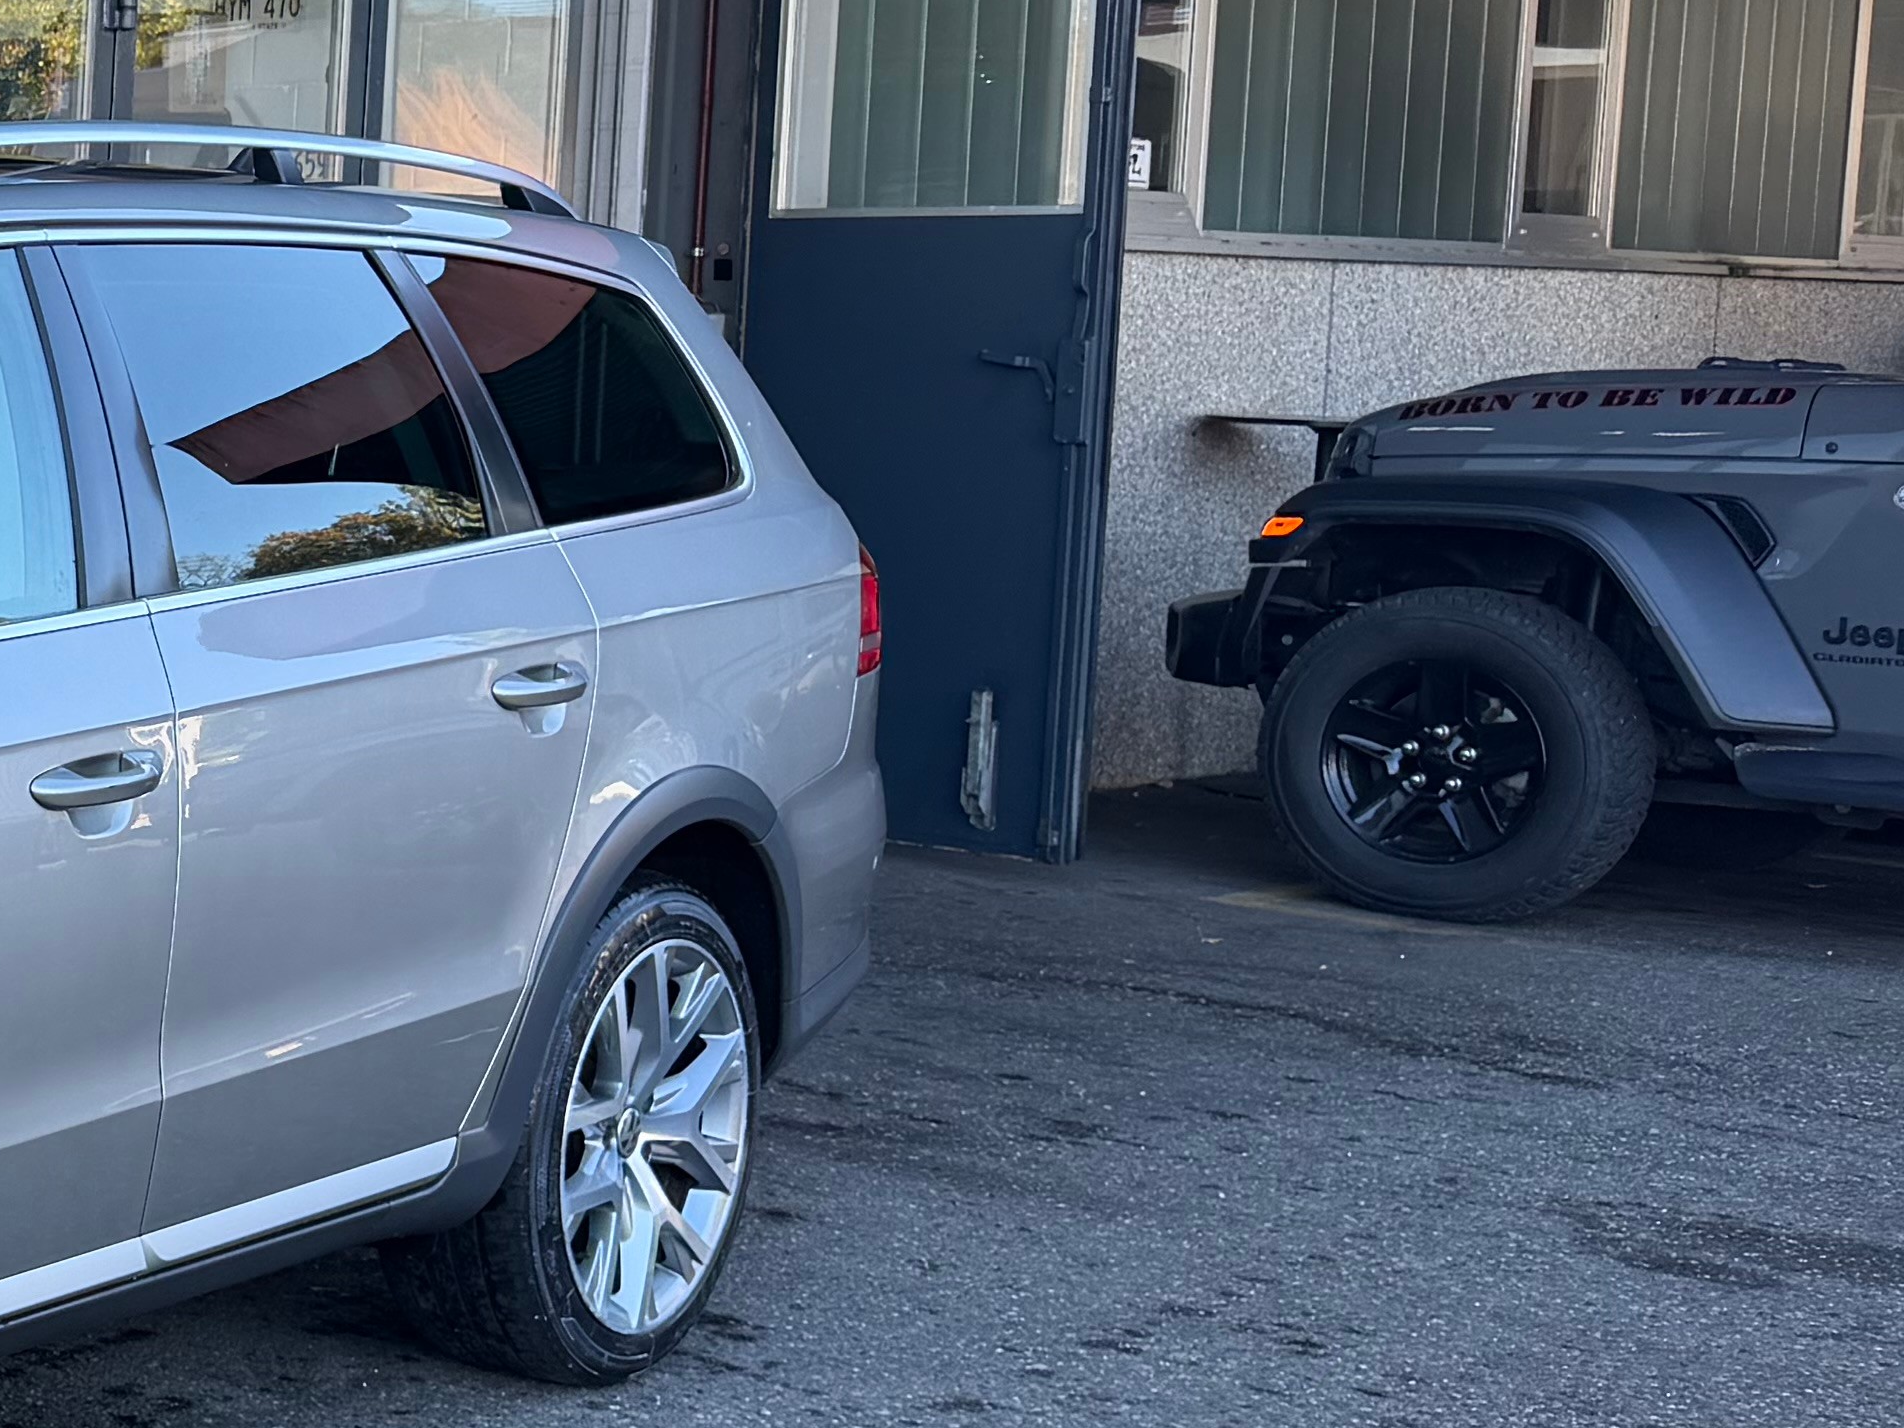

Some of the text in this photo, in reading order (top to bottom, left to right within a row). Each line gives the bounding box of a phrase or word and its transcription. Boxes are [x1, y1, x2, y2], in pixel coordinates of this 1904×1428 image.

[1398, 386, 1797, 421] BORN TO BE WILD
